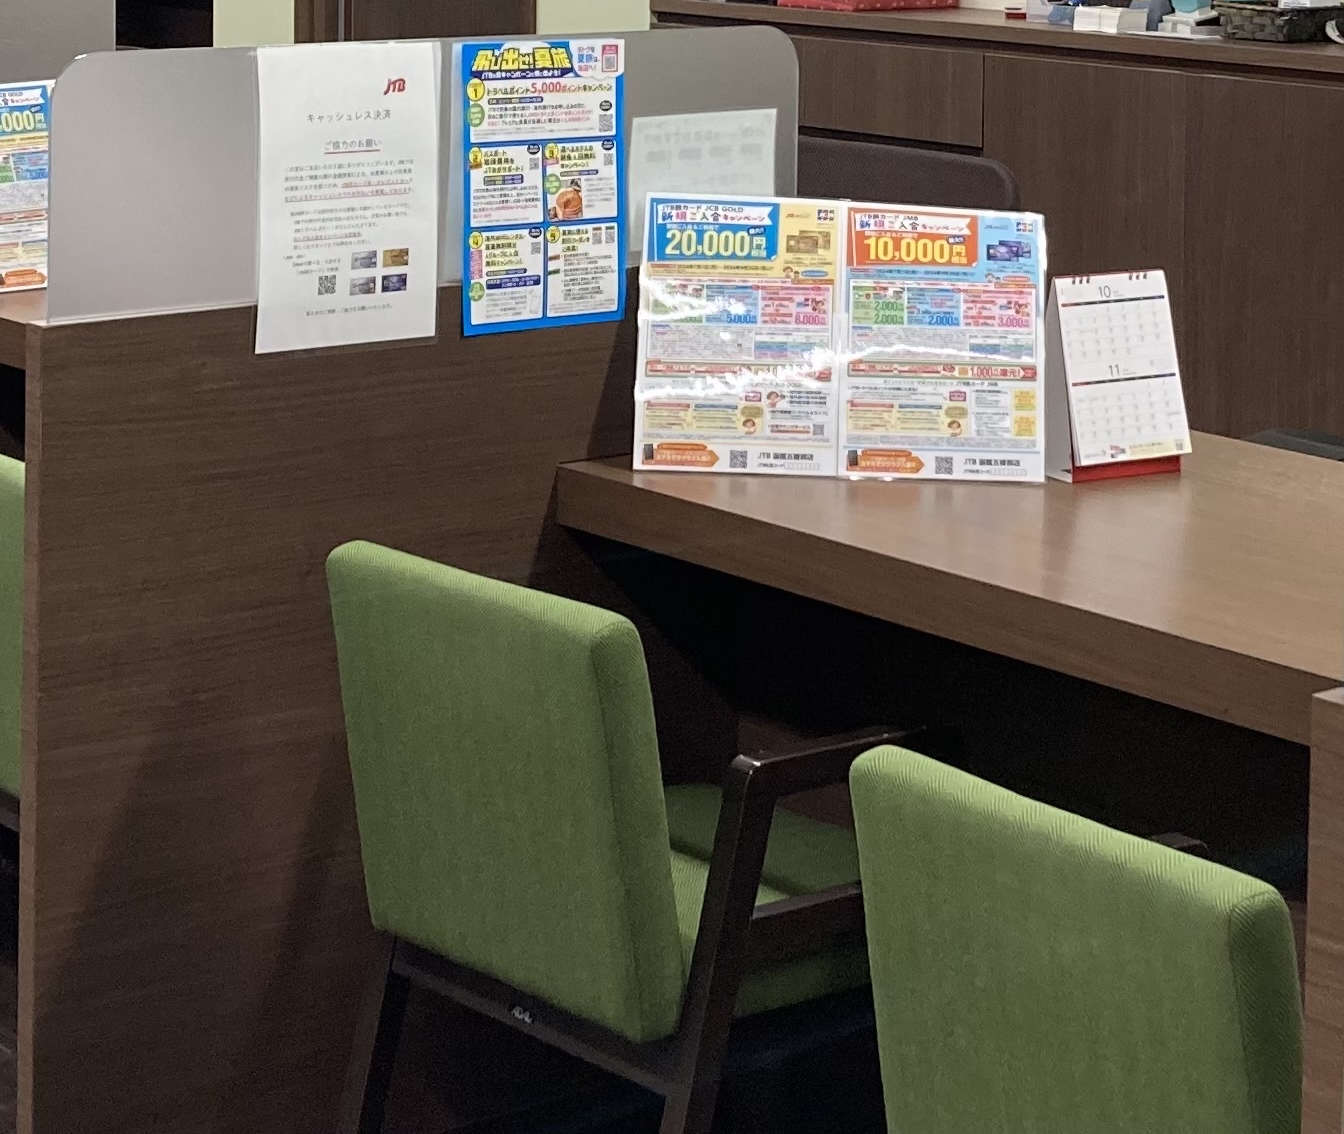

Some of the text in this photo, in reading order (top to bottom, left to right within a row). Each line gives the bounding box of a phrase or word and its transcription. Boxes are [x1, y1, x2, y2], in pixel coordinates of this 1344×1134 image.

[383, 77, 406, 95] JTB
[307, 109, 391, 123] キャッシュレス決済
[324, 138, 382, 150] ご協力のお願い
[1099, 285, 1111, 299] 10
[1109, 364, 1120, 377] 11
